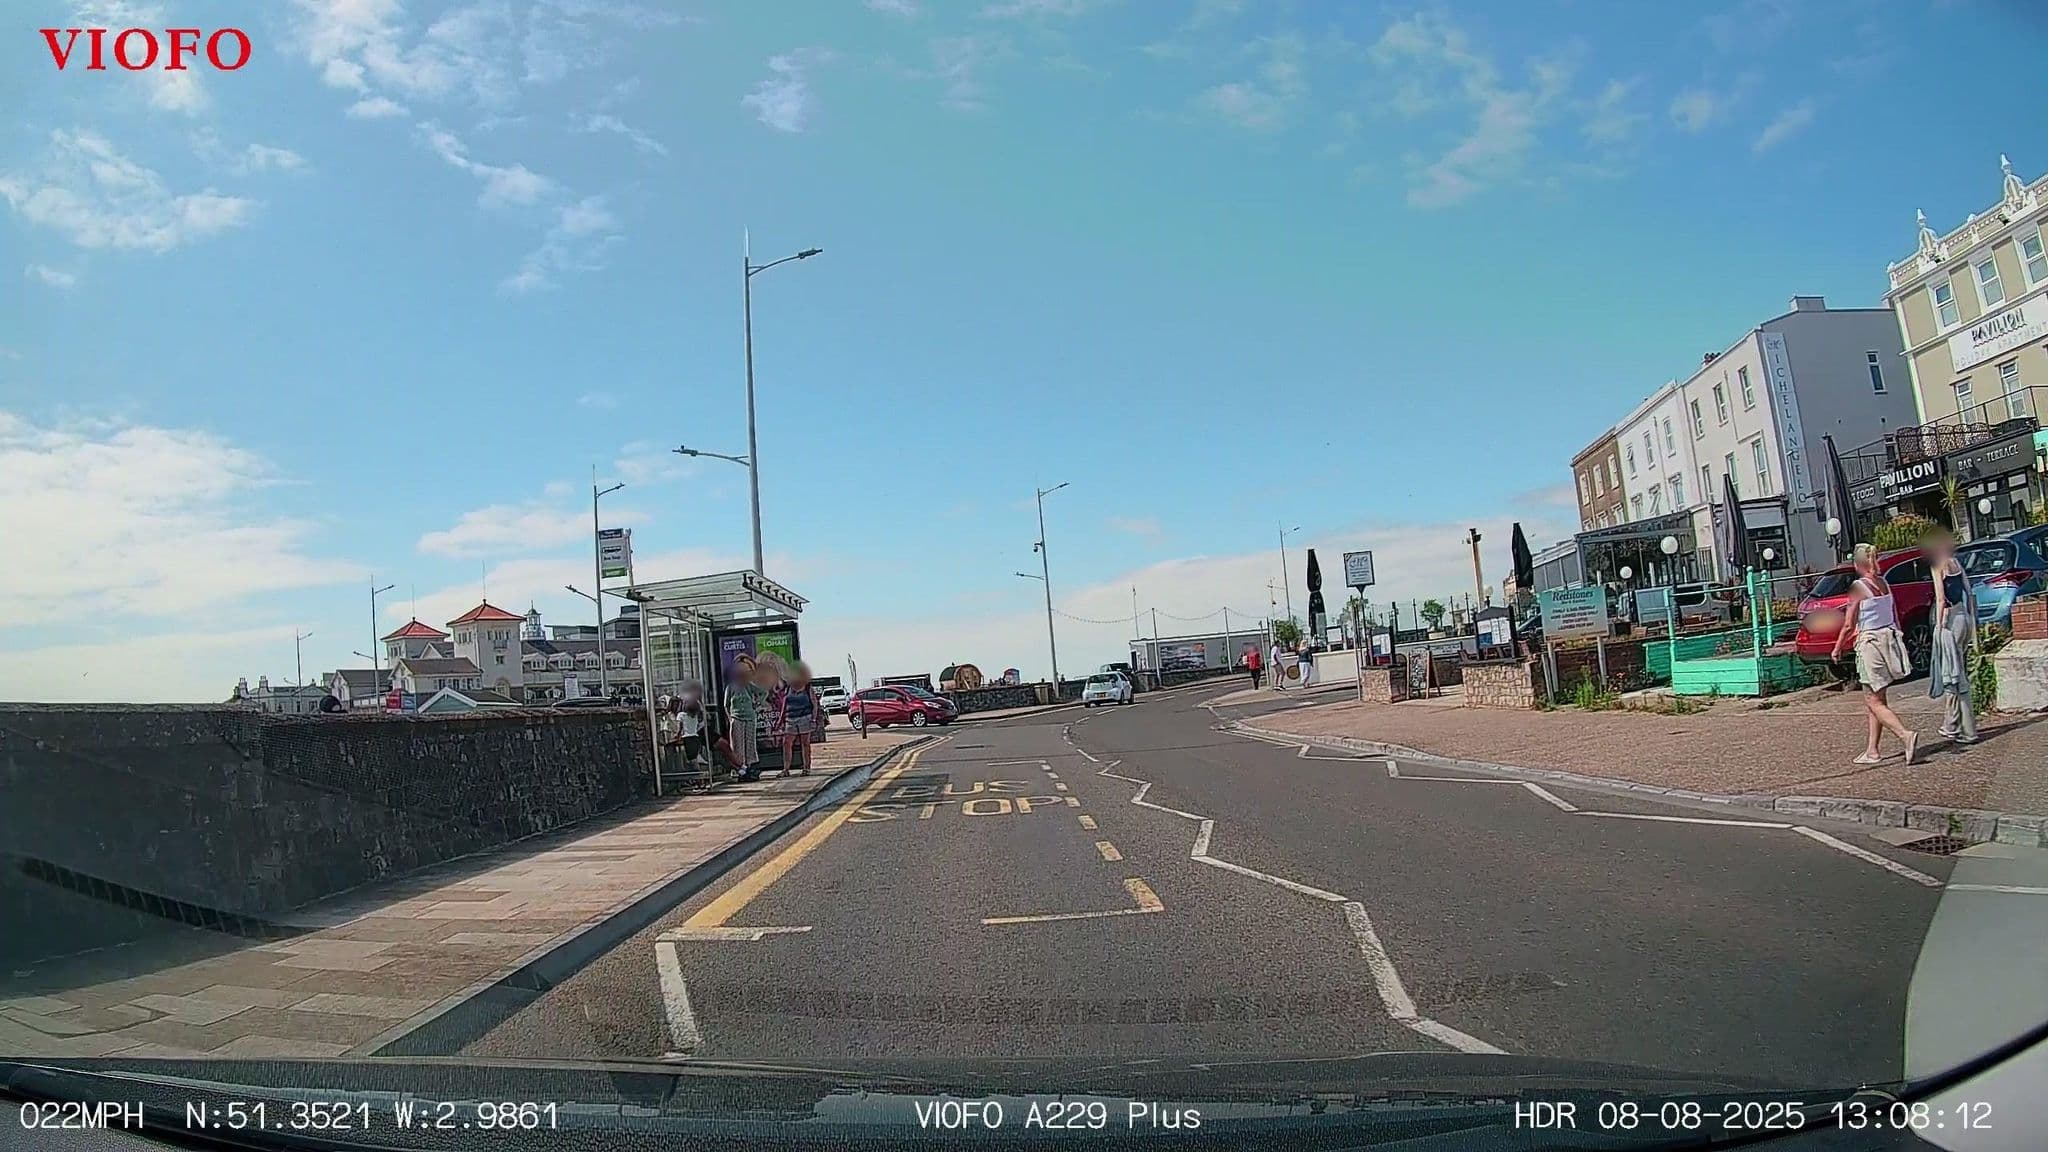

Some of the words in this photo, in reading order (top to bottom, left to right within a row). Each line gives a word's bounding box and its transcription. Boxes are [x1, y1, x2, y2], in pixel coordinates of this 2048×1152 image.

[1971, 308, 2025, 342] PAVILION
[1957, 457, 1974, 471] BAR
[1986, 443, 2019, 462] TERRACE
[1880, 461, 1935, 489] PAVILION
[1899, 484, 1914, 496] BAR
[1552, 590, 1594, 601] Redstones
[891, 780, 1028, 798] BUS
[848, 795, 1064, 823] STOP
